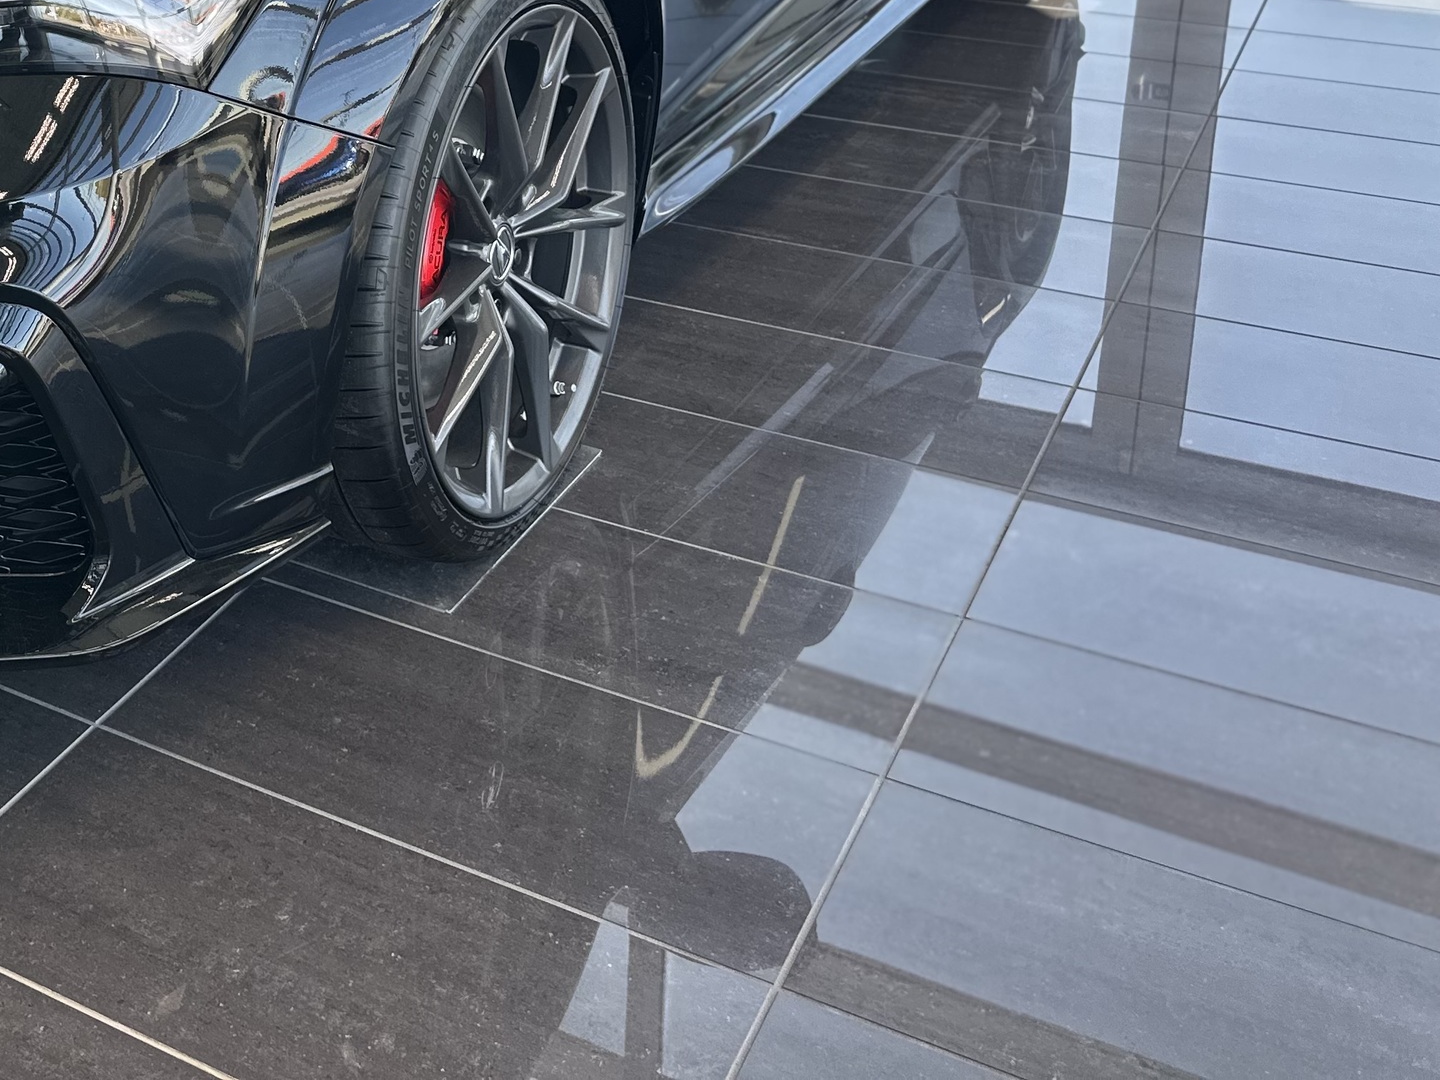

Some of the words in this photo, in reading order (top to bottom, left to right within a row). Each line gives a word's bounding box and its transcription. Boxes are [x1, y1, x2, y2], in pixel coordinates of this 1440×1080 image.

[404, 219, 418, 269] PILOT
[414, 156, 432, 212] SPORT
[431, 208, 449, 284] ACURA
